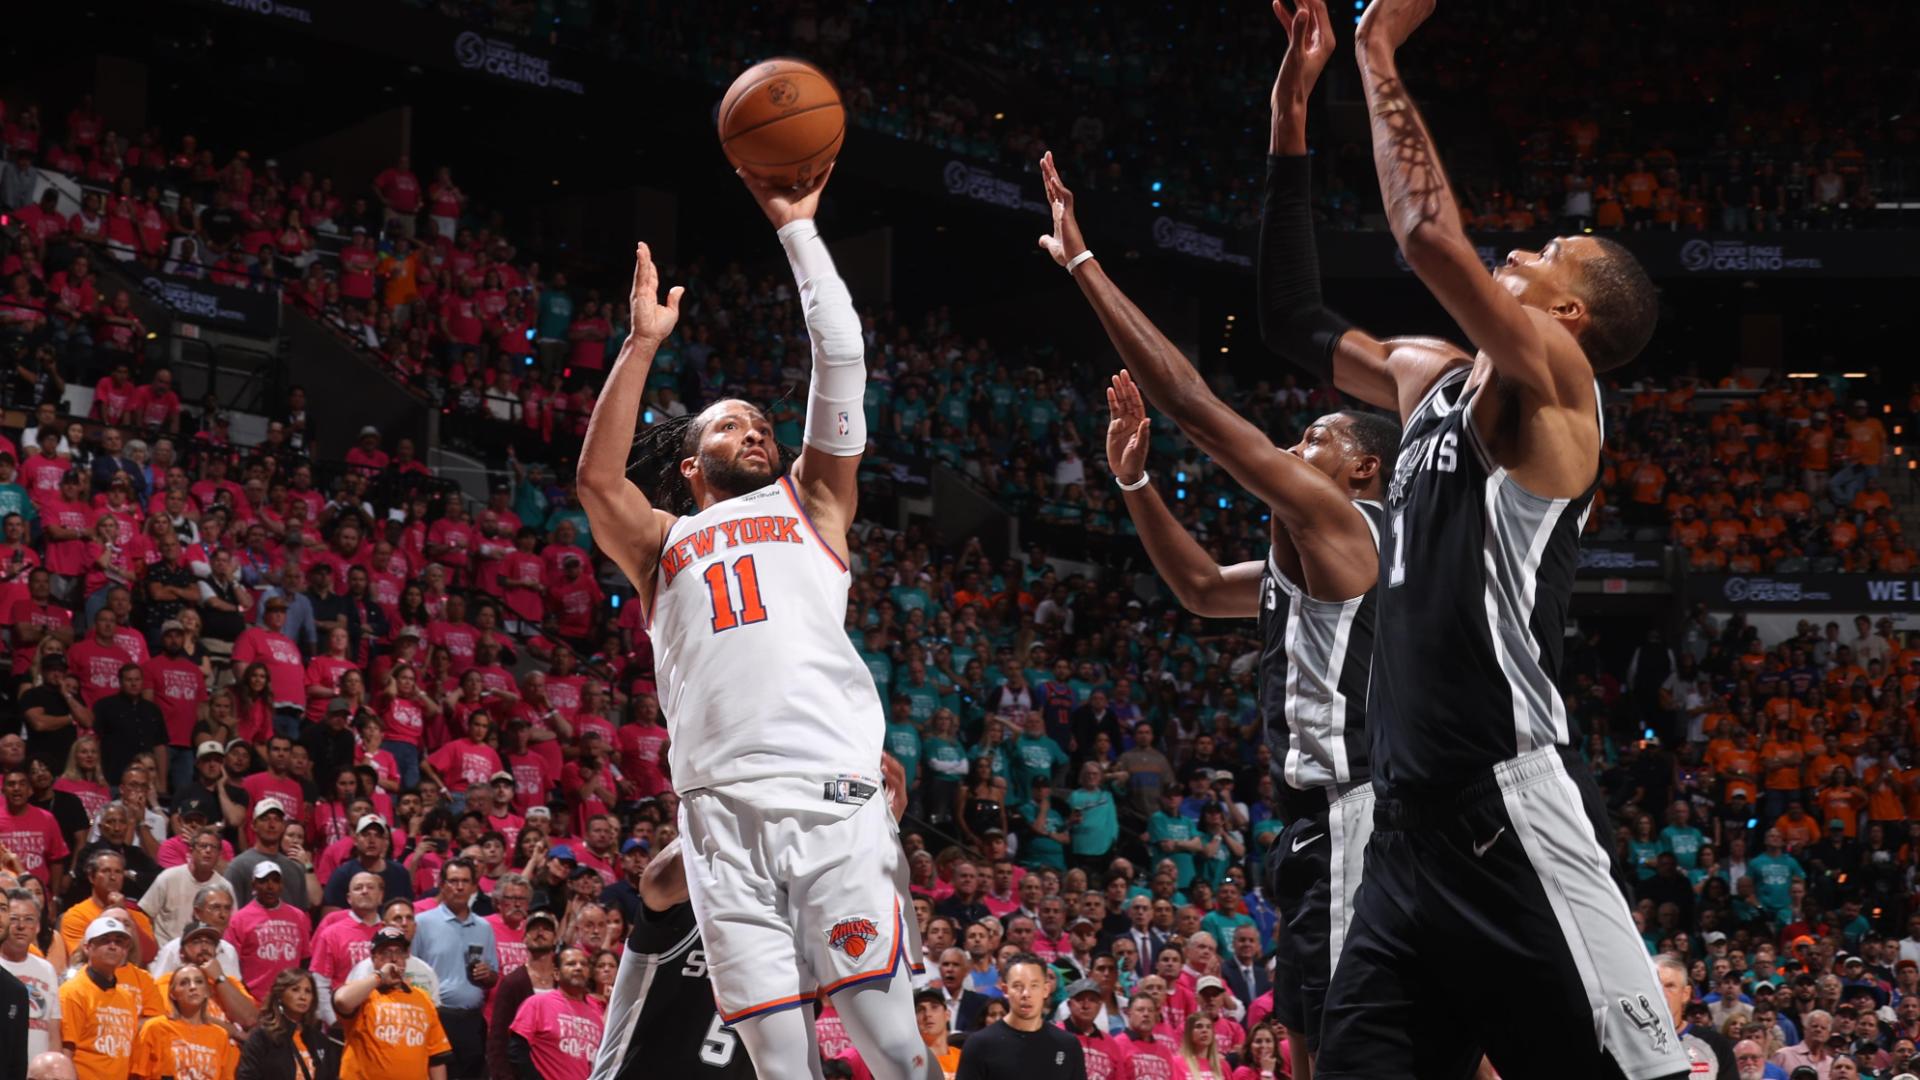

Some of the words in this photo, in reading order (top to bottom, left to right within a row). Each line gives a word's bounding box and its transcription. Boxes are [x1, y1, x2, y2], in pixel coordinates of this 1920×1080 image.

[485, 57, 549, 87] CASINO
[1713, 257, 1783, 271] CASINO
[1749, 246, 1783, 256] EAGLE
[661, 525, 715, 587] NEW
[719, 515, 804, 548] YORK
[1389, 510, 1405, 588] 1
[703, 554, 768, 634] 11
[1866, 581, 1907, 601] WE
[829, 919, 879, 945] KNICKS
[375, 1026, 399, 1045] GO
[406, 1027, 424, 1047] GO
[699, 1011, 736, 1068] 5
